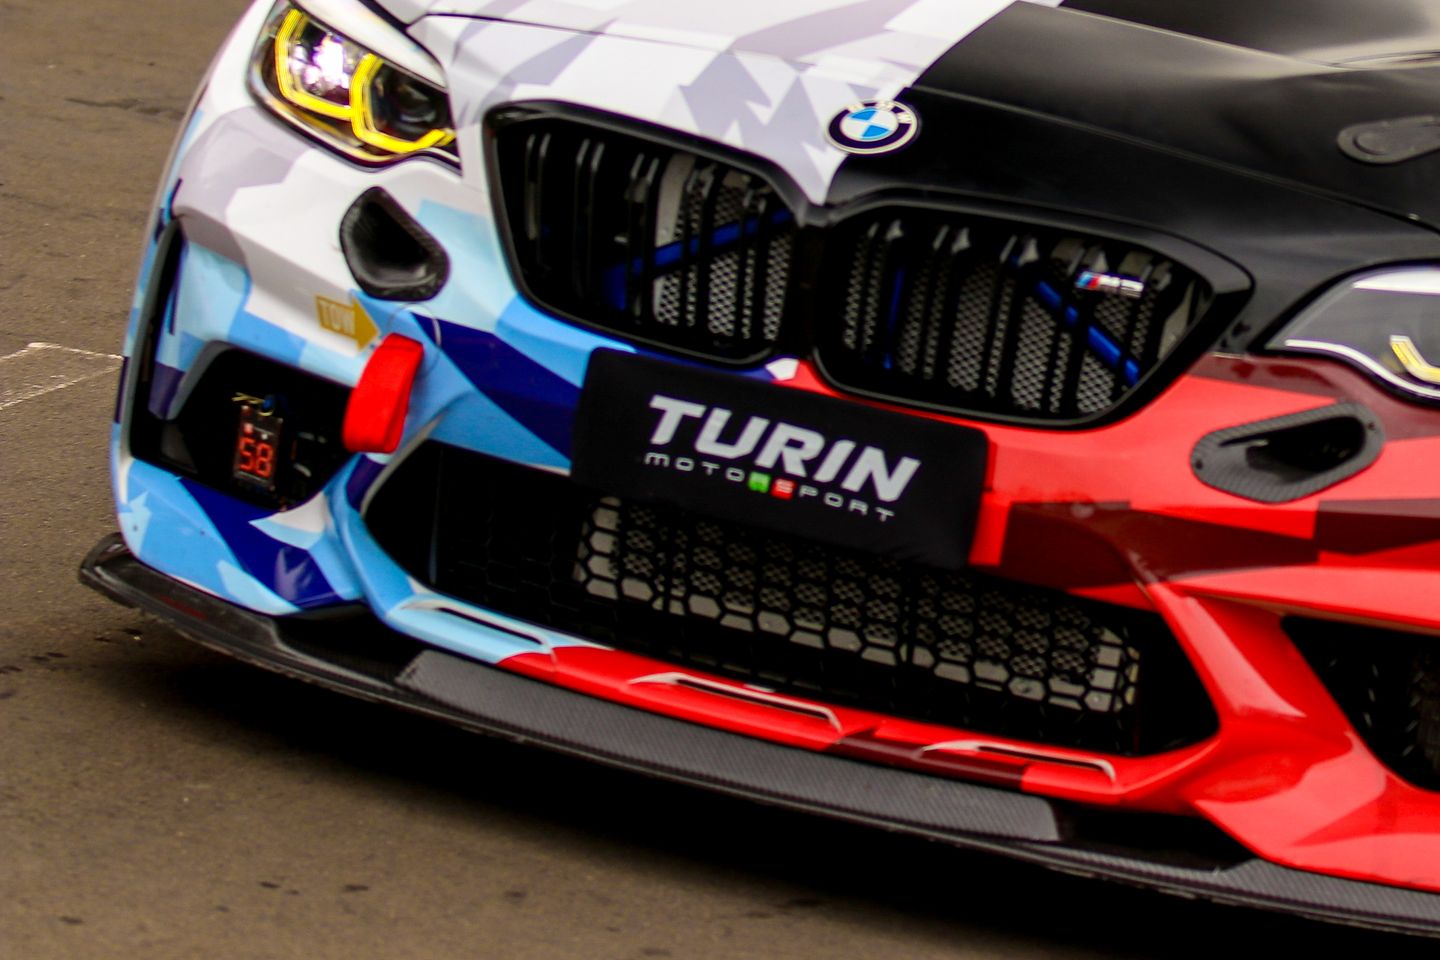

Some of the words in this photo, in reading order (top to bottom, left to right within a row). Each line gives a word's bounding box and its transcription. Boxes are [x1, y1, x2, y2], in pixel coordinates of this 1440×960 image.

[239, 437, 273, 478] 58
[649, 394, 922, 502] TURIN
[644, 451, 895, 523] MOTORSPORT
